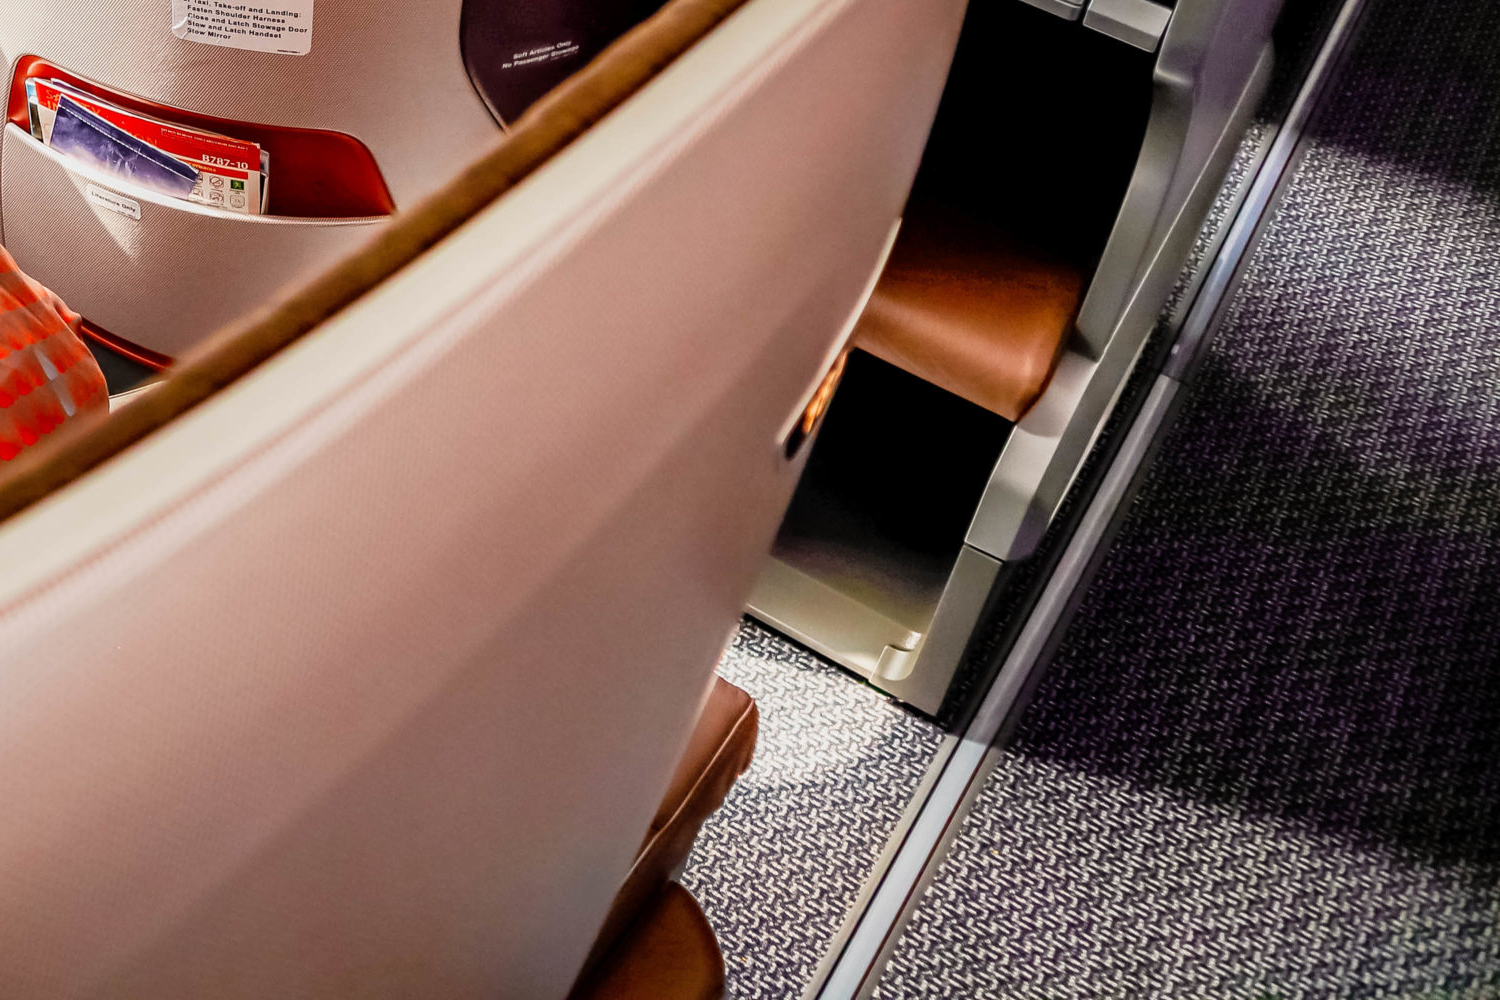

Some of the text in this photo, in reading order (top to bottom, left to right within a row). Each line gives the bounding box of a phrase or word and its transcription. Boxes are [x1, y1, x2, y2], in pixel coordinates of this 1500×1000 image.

[187, 5, 286, 24] Fasten Shoulder Harness
[214, 1, 246, 12] Take-off
[266, 8, 302, 18] Landing:
[187, 12, 209, 21] Close
[228, 18, 250, 27] Latch
[252, 23, 286, 32] Stowage
[187, 20, 206, 28] Stow
[225, 26, 247, 35] Latch
[249, 30, 282, 39] Handset
[187, 27, 232, 40] Stow Mirror
[202, 153, 249, 170] B787-10
